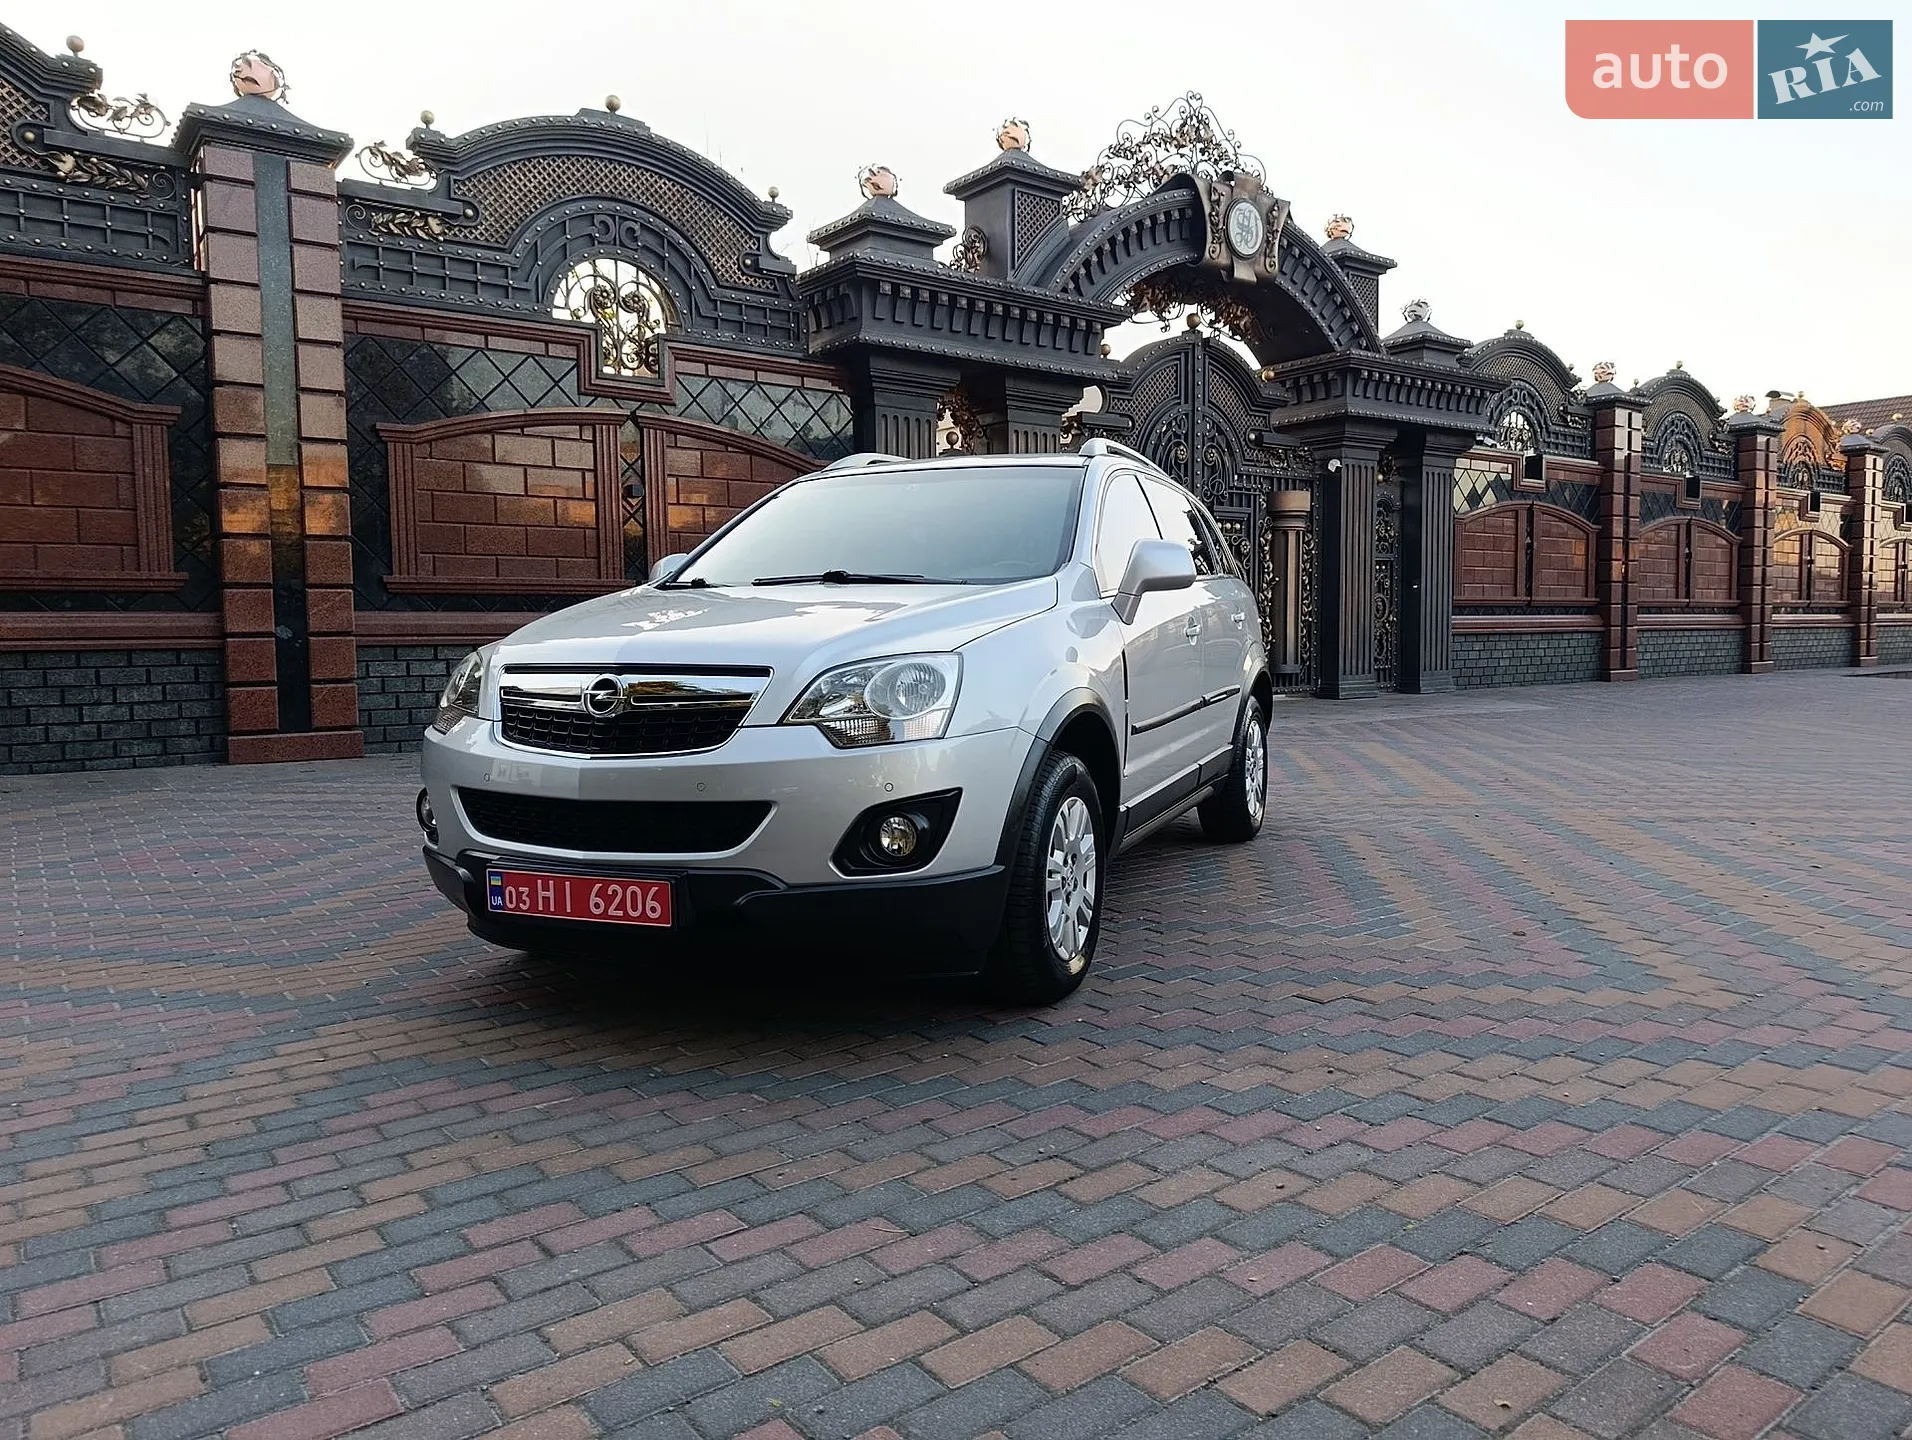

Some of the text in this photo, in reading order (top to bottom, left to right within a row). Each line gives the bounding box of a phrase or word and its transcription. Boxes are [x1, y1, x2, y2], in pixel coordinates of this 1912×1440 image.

[491, 895, 503, 906] UA
[505, 879, 662, 919] 03 HI 6206
